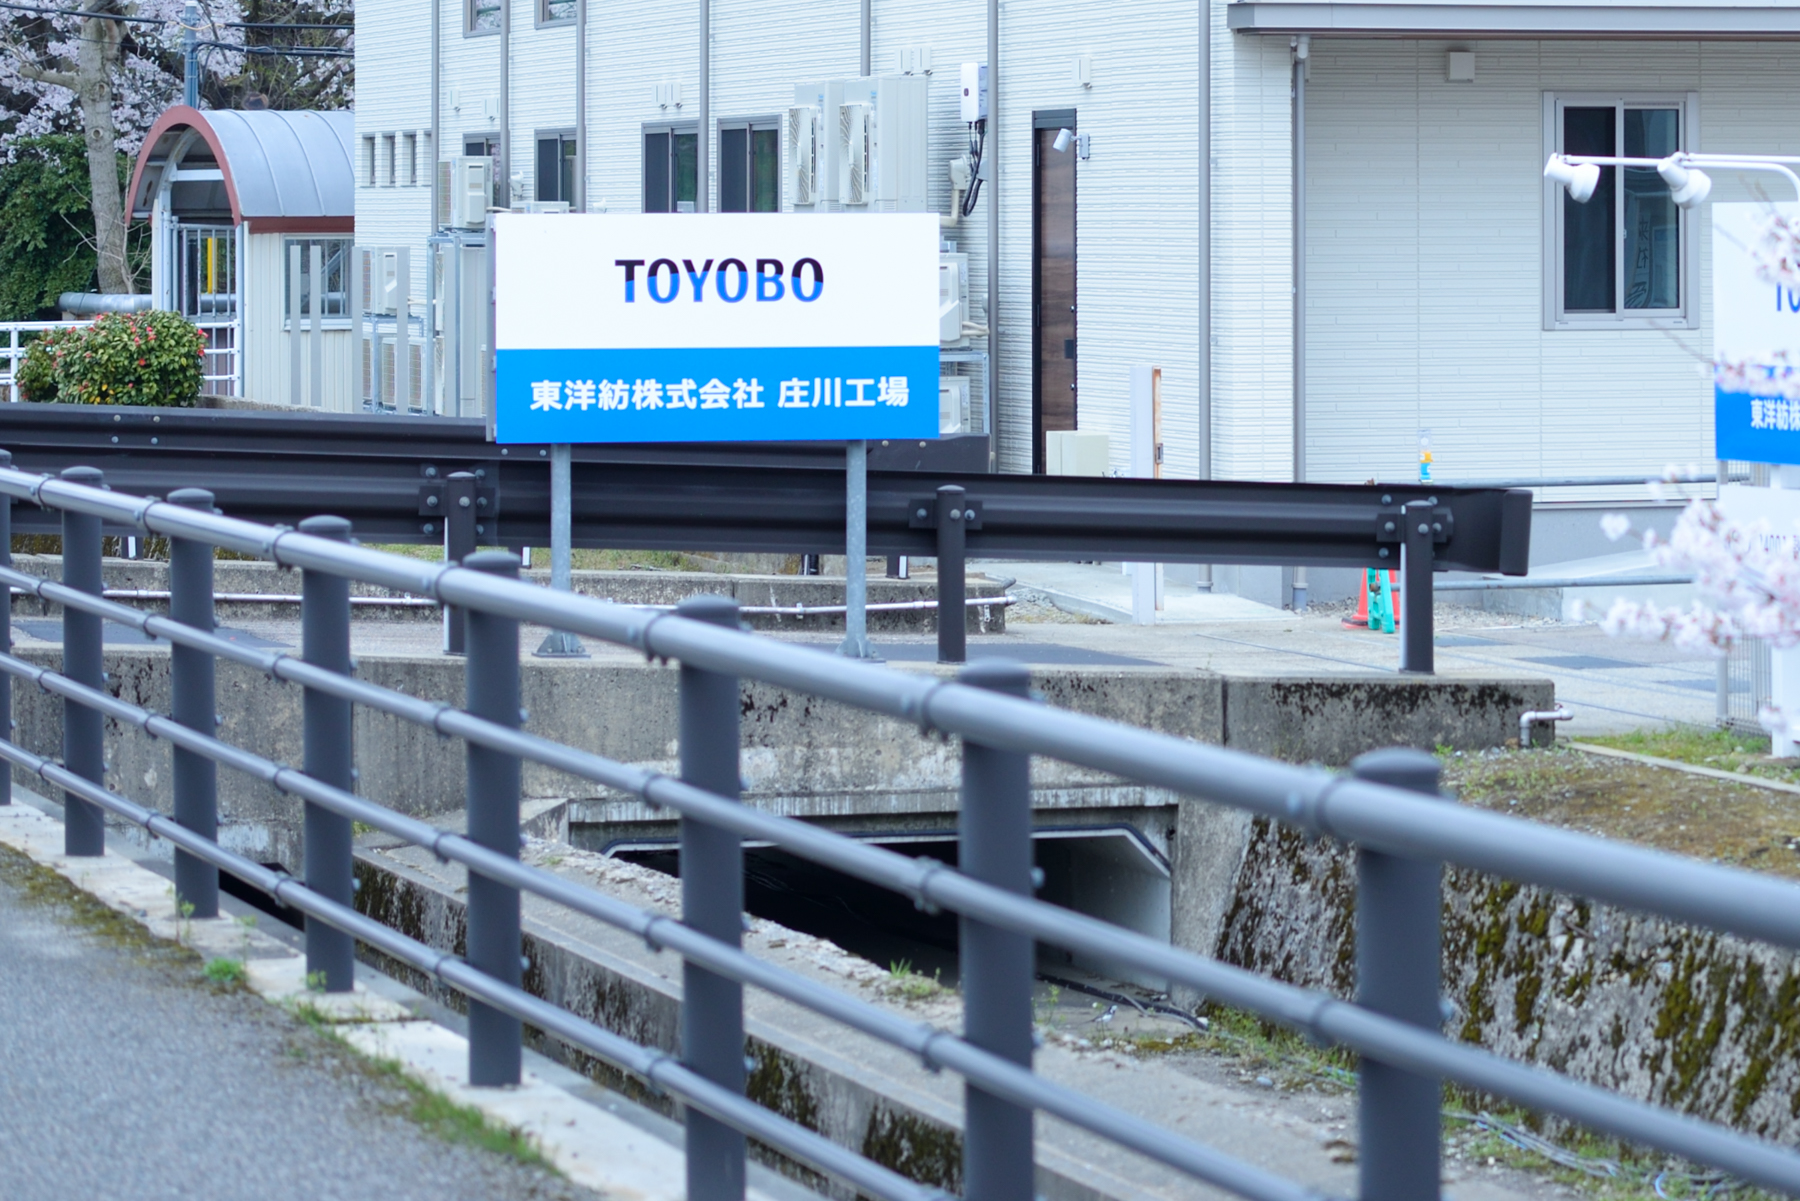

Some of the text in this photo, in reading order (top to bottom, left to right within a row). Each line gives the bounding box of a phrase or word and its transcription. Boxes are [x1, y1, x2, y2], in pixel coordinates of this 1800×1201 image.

[614, 256, 825, 304] TOYOBO
[529, 375, 911, 412] 東洋紡株式会社 庄川工場
